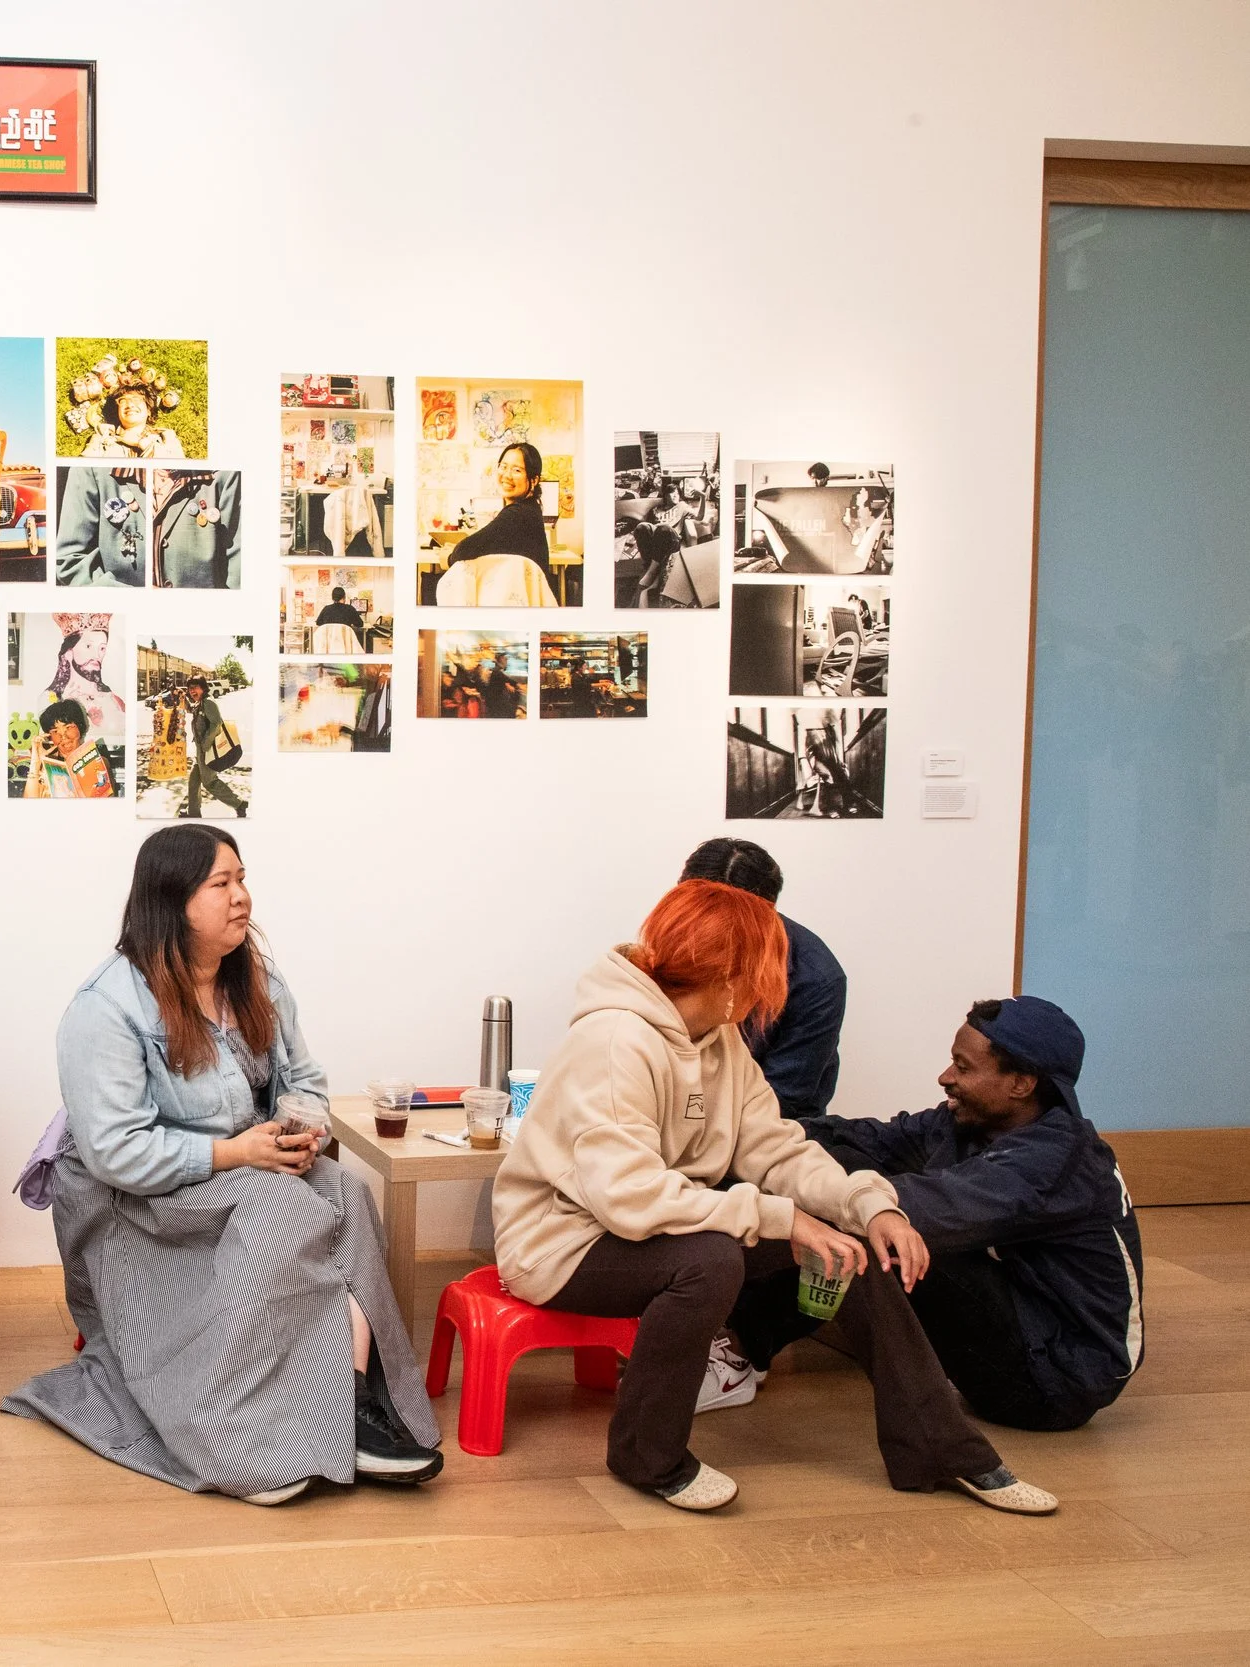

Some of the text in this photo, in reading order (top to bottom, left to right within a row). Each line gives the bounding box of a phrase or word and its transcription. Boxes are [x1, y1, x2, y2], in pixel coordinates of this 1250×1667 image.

[27, 159, 43, 170] TEA
[43, 160, 66, 170] SHOP
[812, 1272, 843, 1291] TIME
[809, 1289, 837, 1307] LESS
